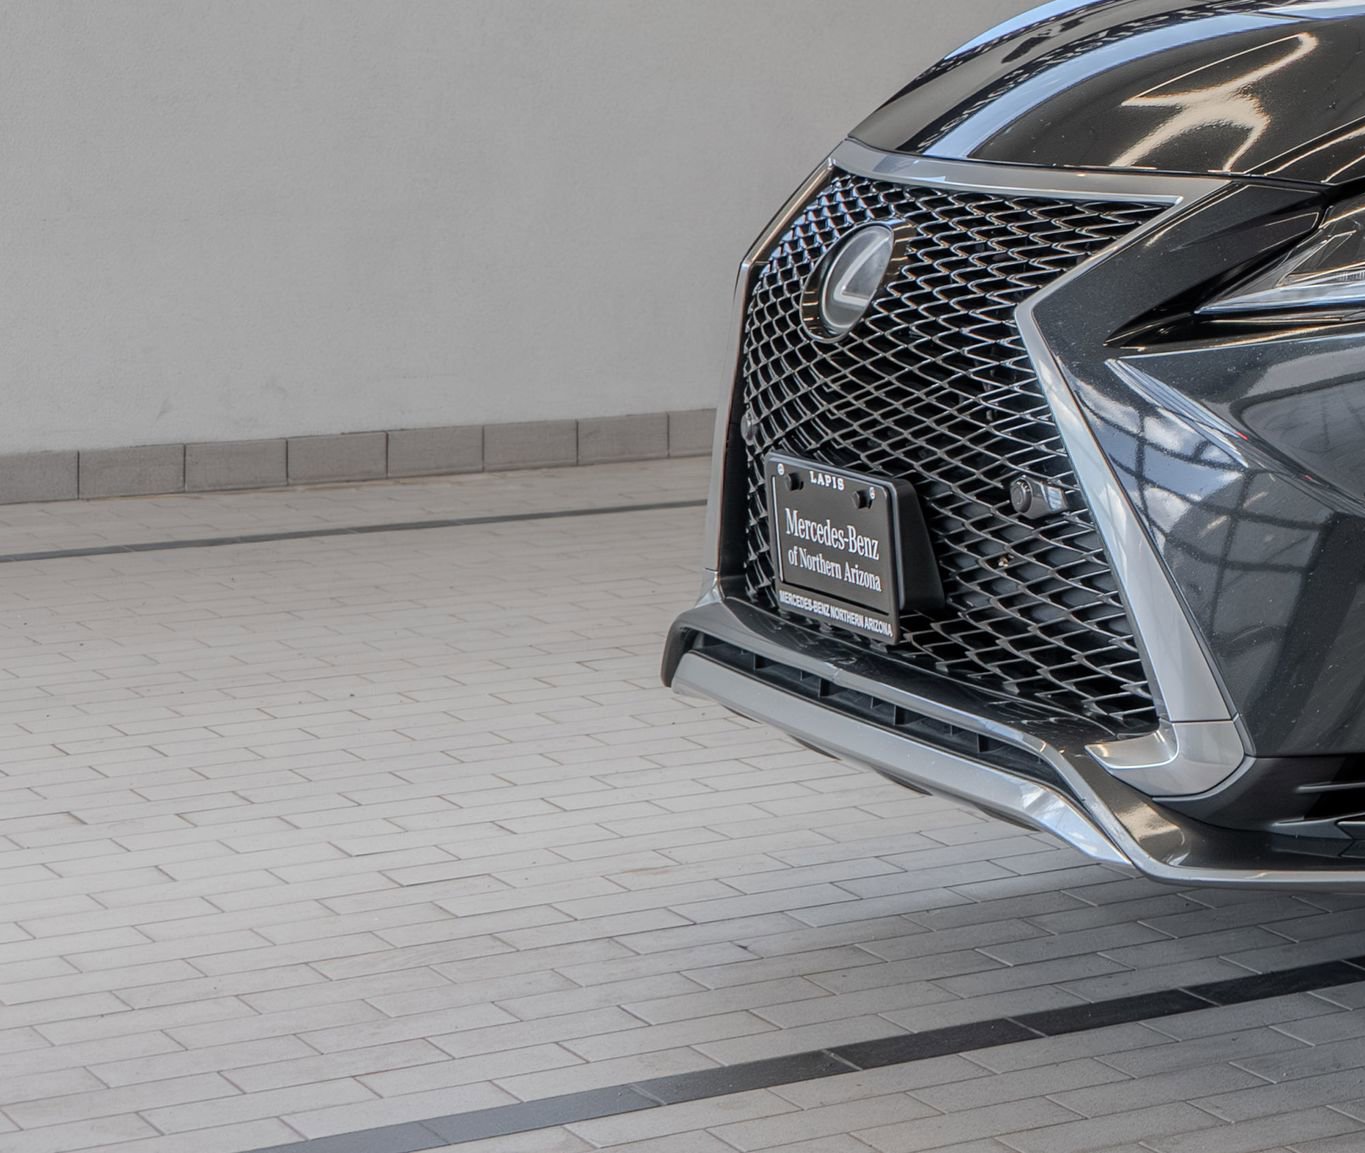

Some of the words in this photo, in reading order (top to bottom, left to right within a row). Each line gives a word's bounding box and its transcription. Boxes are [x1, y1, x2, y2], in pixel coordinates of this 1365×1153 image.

[809, 470, 844, 491] LAPIS
[784, 507, 880, 561] Mercedes-Benz
[788, 545, 800, 566] of
[799, 547, 841, 578] Northern
[844, 561, 882, 592] Arizona
[779, 589, 831, 617] MERCEDES-BENZ
[830, 605, 864, 627] NORTHERN
[864, 616, 893, 638] ARIZONA
